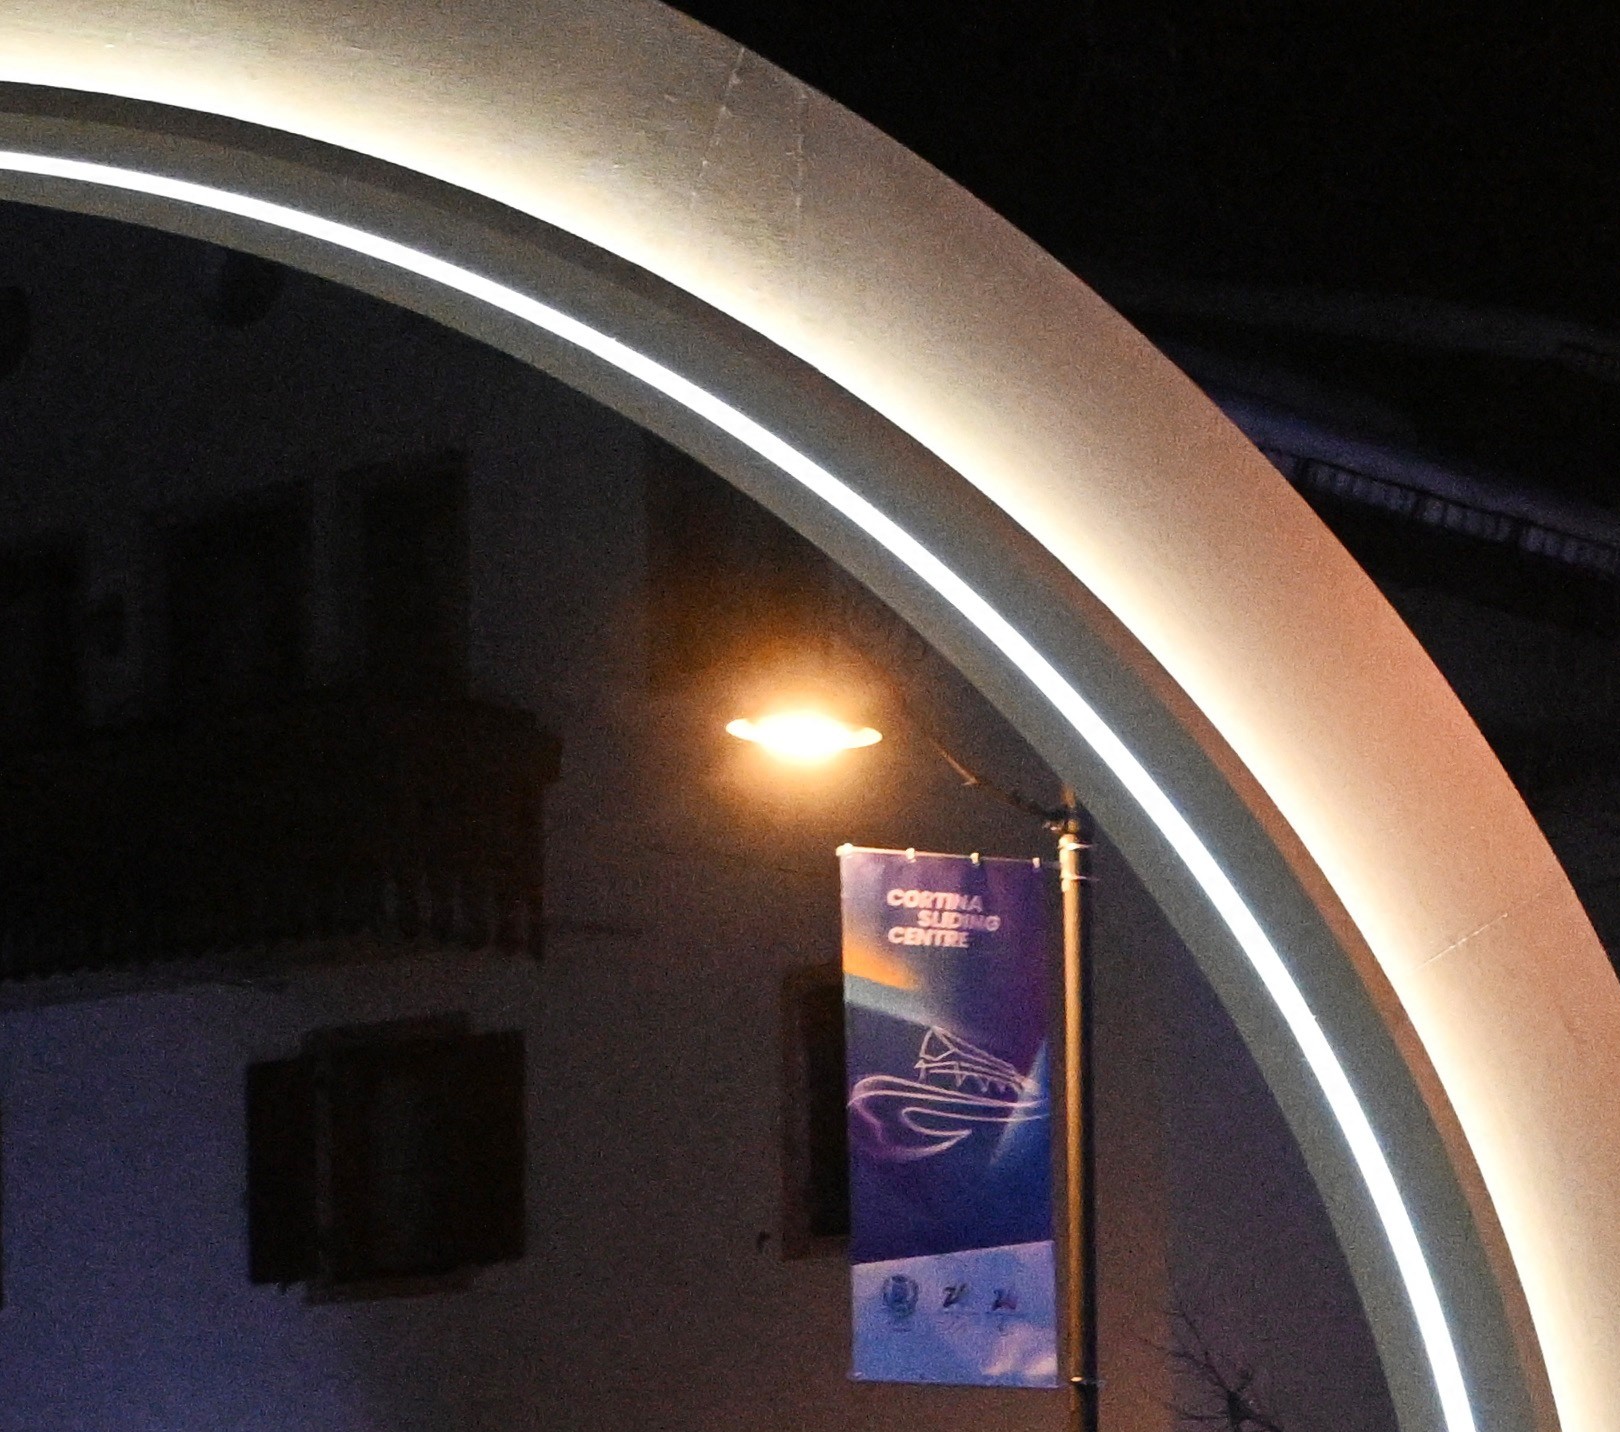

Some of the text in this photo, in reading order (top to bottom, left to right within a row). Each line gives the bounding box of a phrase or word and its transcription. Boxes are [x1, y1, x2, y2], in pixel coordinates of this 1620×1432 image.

[886, 889, 983, 913] CORTINA
[917, 909, 1001, 932] SLIDING
[887, 926, 970, 948] CENTRE
